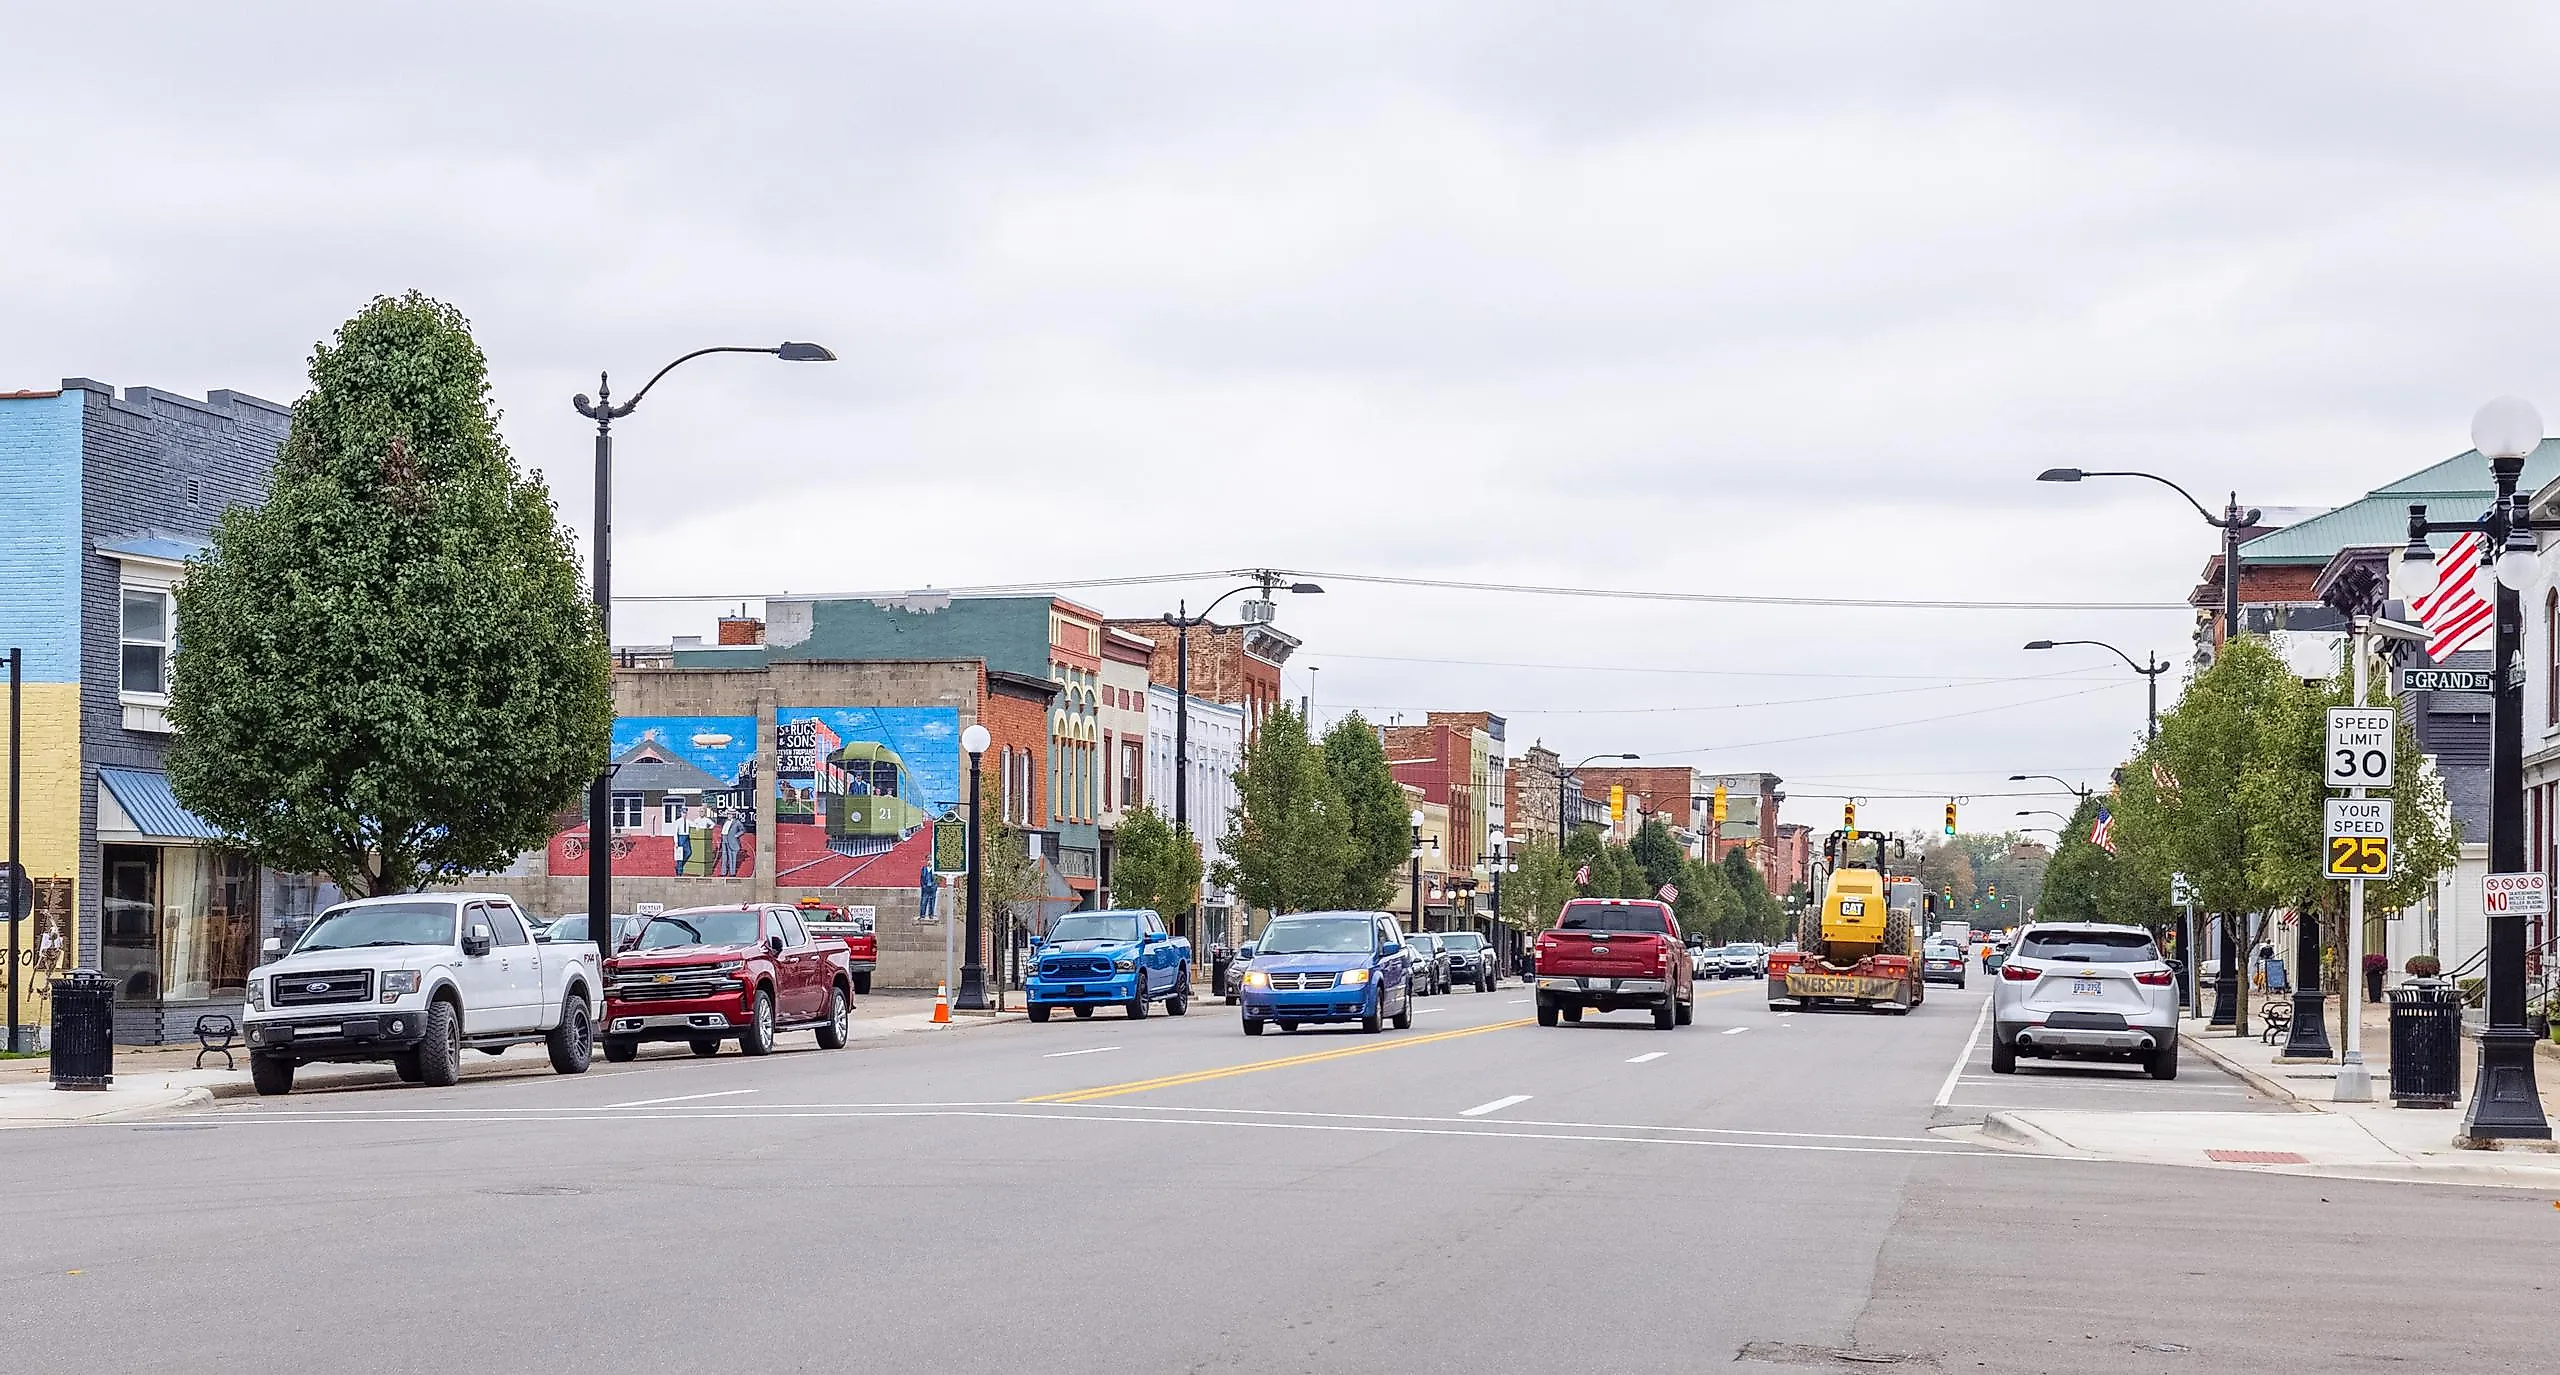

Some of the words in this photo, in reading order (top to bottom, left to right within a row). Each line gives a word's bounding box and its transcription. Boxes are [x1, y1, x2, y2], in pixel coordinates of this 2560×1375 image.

[2406, 675, 2414, 684] S
[2415, 672, 2473, 689] GRAND
[2475, 675, 2489, 687] ST
[791, 723, 816, 736] RUGS
[2334, 717, 2389, 730] SPEED
[786, 734, 816, 748] SONS
[2339, 733, 2383, 746] LIMIT
[787, 755, 816, 767] STORE
[2334, 749, 2387, 778] 30
[716, 791, 750, 809] BULL
[879, 808, 891, 820] 21
[2339, 805, 2380, 818] YOUR
[2333, 821, 2384, 833] SPEED
[2331, 837, 2387, 874] 25
[2487, 892, 2508, 911] NO
[1842, 903, 1863, 916] CAT
[583, 954, 595, 963] FX4
[1791, 977, 1855, 993] OVERSIZE
